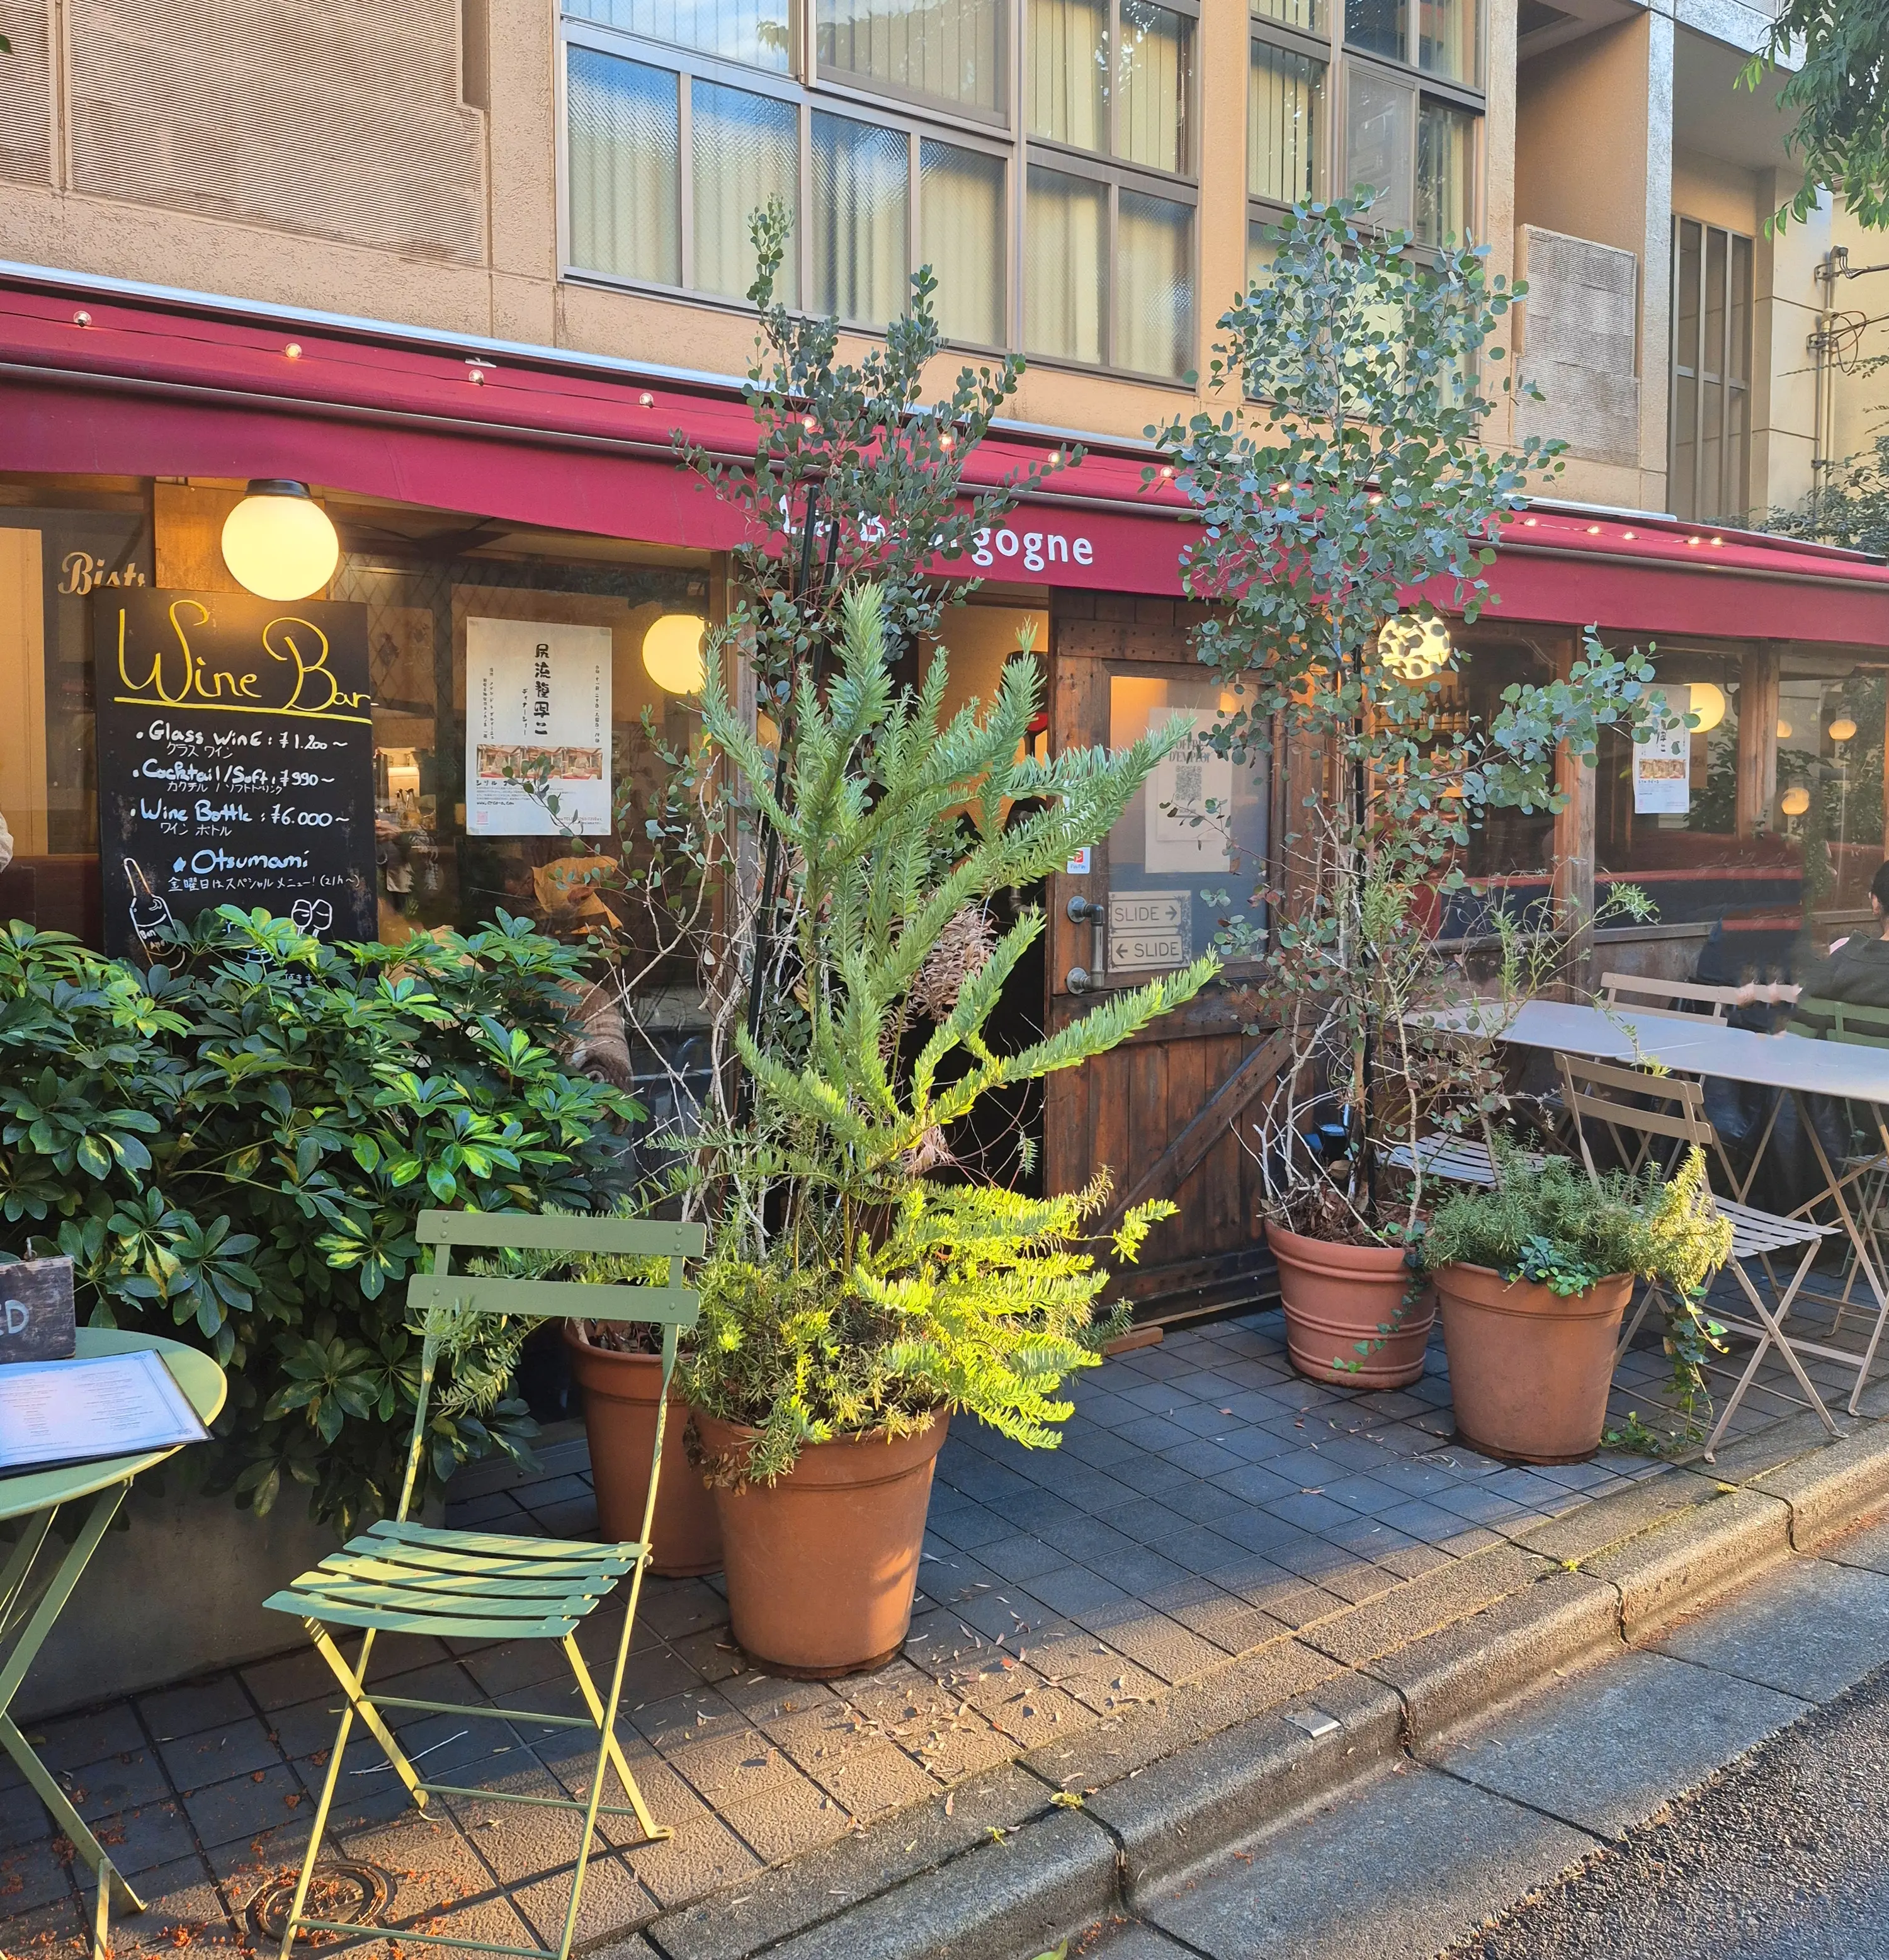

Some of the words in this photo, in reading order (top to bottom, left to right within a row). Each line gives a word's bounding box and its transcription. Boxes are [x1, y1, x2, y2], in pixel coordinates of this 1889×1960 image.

[857, 509, 1093, 571] Bgogne
[118, 600, 262, 703] Wine
[262, 617, 380, 712] Bar
[149, 720, 204, 744] Glass
[204, 746, 233, 759] ワイン
[140, 797, 189, 821] Wine
[160, 822, 189, 836] ワイン
[195, 824, 232, 836] ボトル
[191, 847, 310, 874] Otsumami
[1115, 906, 1160, 922] SLIDE
[1134, 942, 1179, 957] SLIDE
